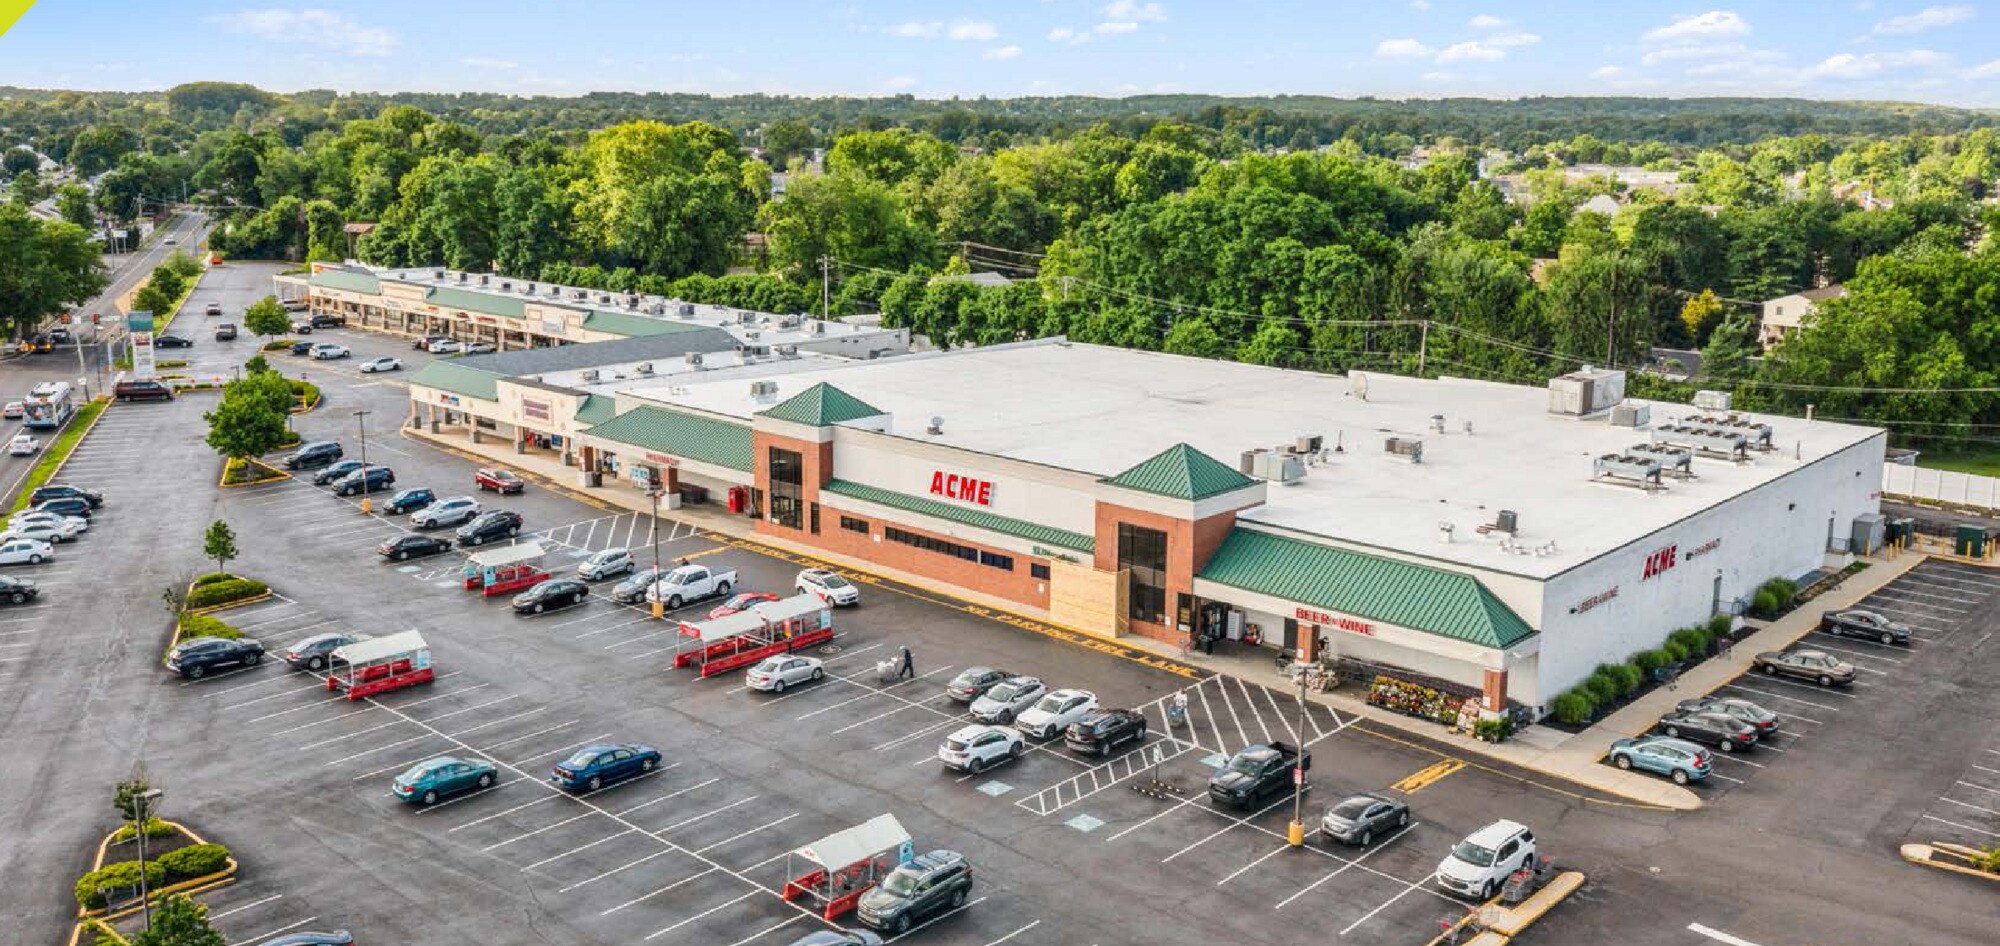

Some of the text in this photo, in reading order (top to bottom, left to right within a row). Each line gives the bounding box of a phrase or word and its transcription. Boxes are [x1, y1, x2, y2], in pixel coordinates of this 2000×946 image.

[930, 471, 991, 505] ACME
[1643, 545, 1677, 581] ACME
[1295, 607, 1329, 625] BEER
[1339, 618, 1376, 636] WINE
